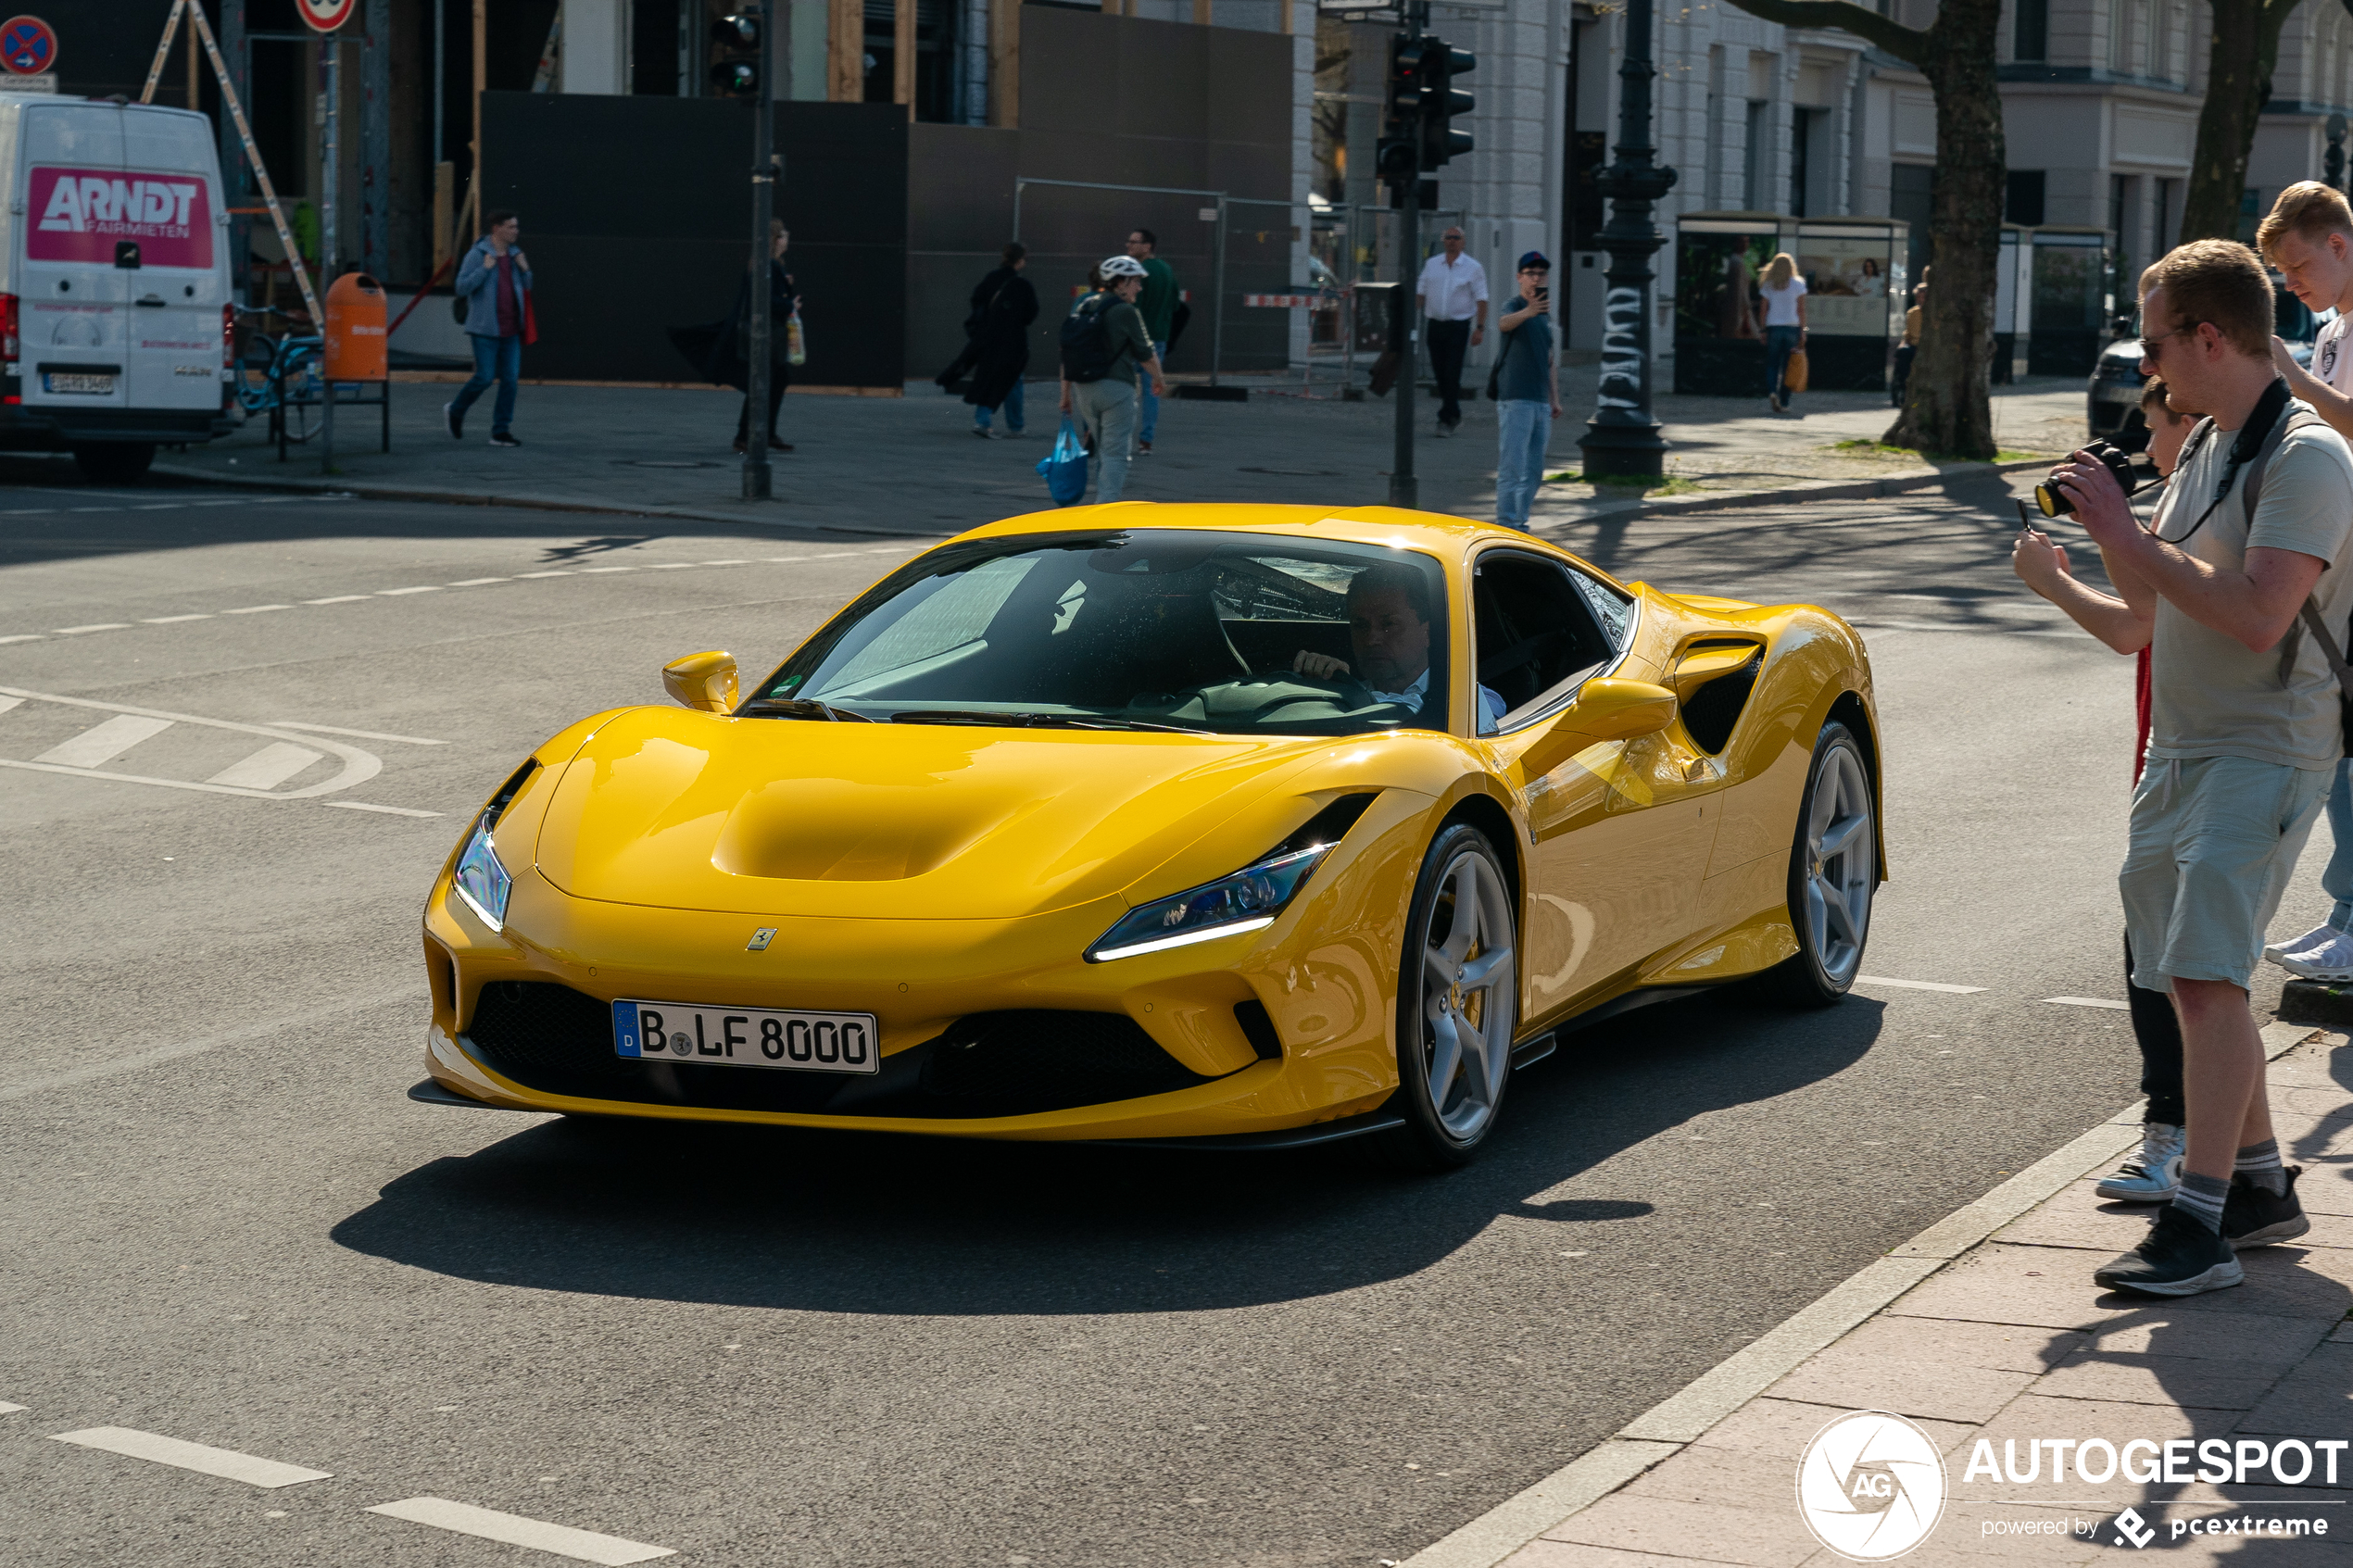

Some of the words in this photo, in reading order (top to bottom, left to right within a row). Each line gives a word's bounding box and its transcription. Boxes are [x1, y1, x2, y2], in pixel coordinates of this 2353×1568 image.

[37, 176, 197, 232] ARNDT
[85, 220, 190, 238] FAIRMIETEN
[623, 1035, 634, 1047] D
[639, 1010, 667, 1052] B
[695, 1013, 749, 1058] LF
[760, 1018, 867, 1065] 8000
